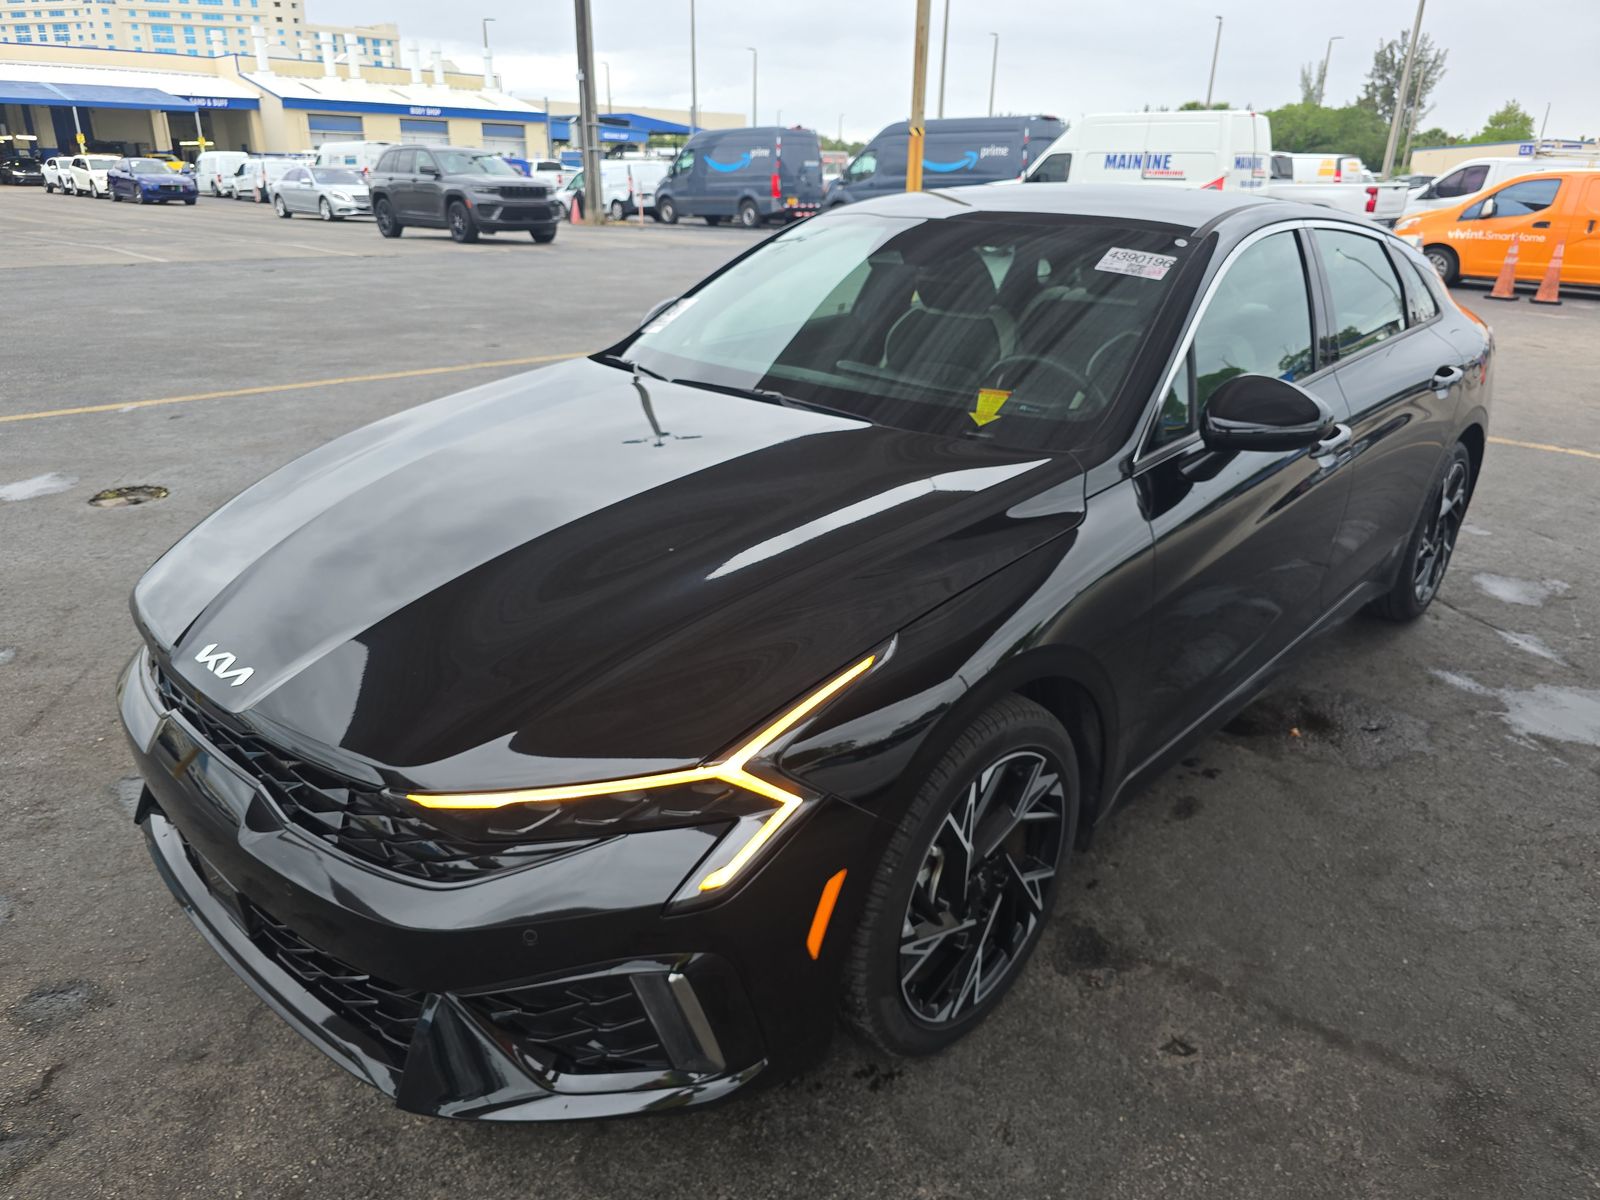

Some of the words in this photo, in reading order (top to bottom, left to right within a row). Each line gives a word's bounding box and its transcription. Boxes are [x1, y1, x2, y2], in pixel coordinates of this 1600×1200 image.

[980, 144, 1008, 159] prime
[1104, 154, 1171, 170] MAININE
[1109, 251, 1174, 268] 4390196
[194, 643, 255, 688] KIA
